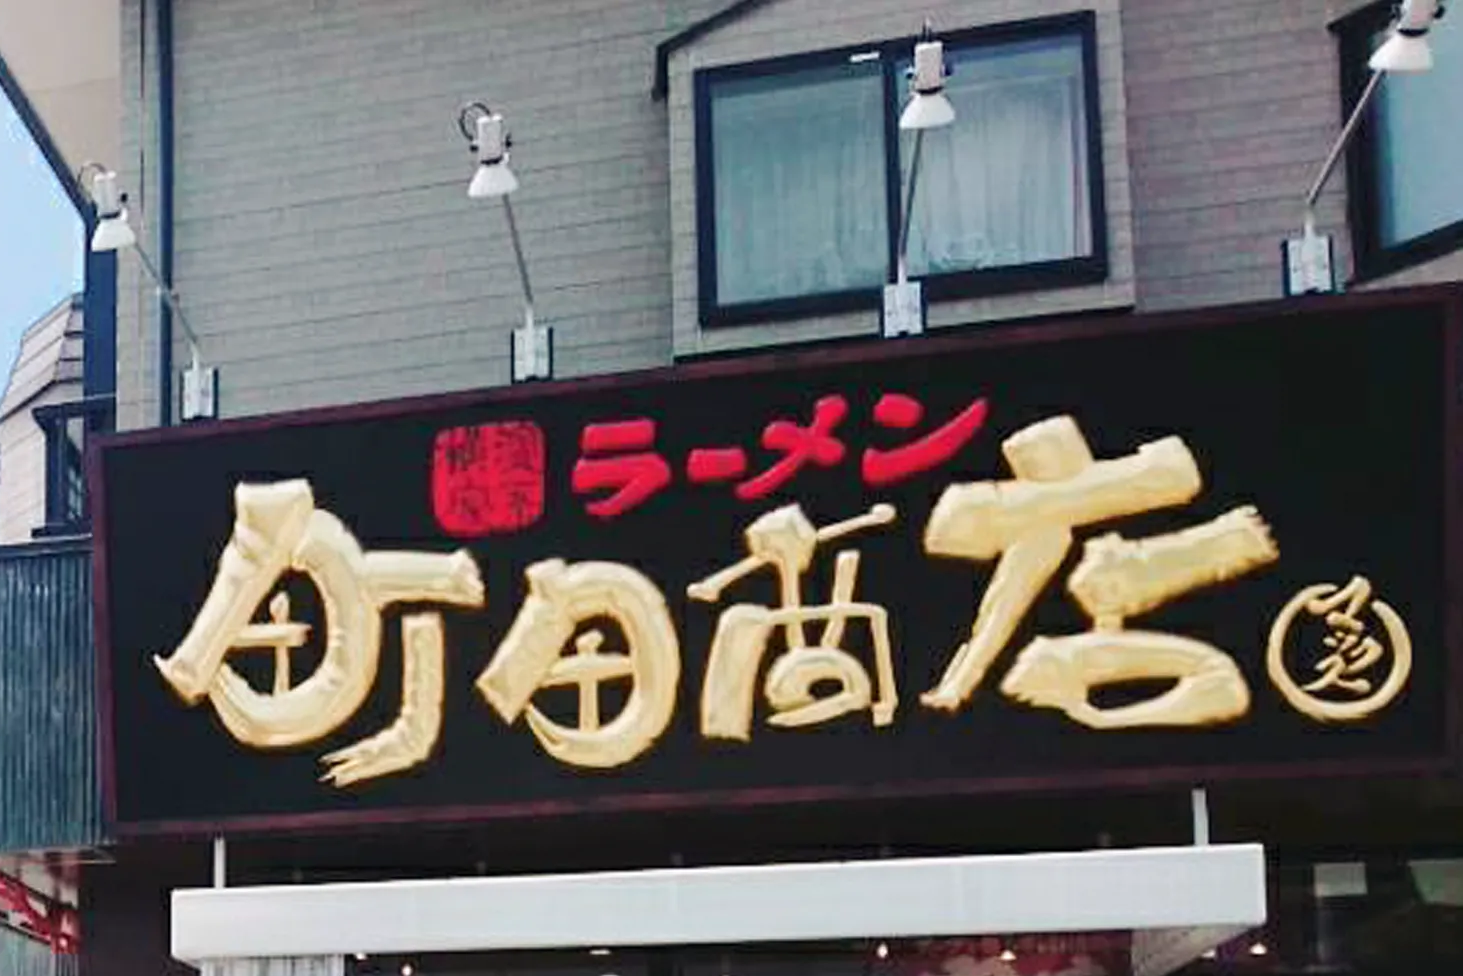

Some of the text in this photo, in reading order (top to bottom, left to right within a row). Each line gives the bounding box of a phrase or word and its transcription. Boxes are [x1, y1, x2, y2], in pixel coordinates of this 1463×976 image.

[571, 393, 989, 518] ラーメン
[152, 413, 1281, 789] 町田商店
